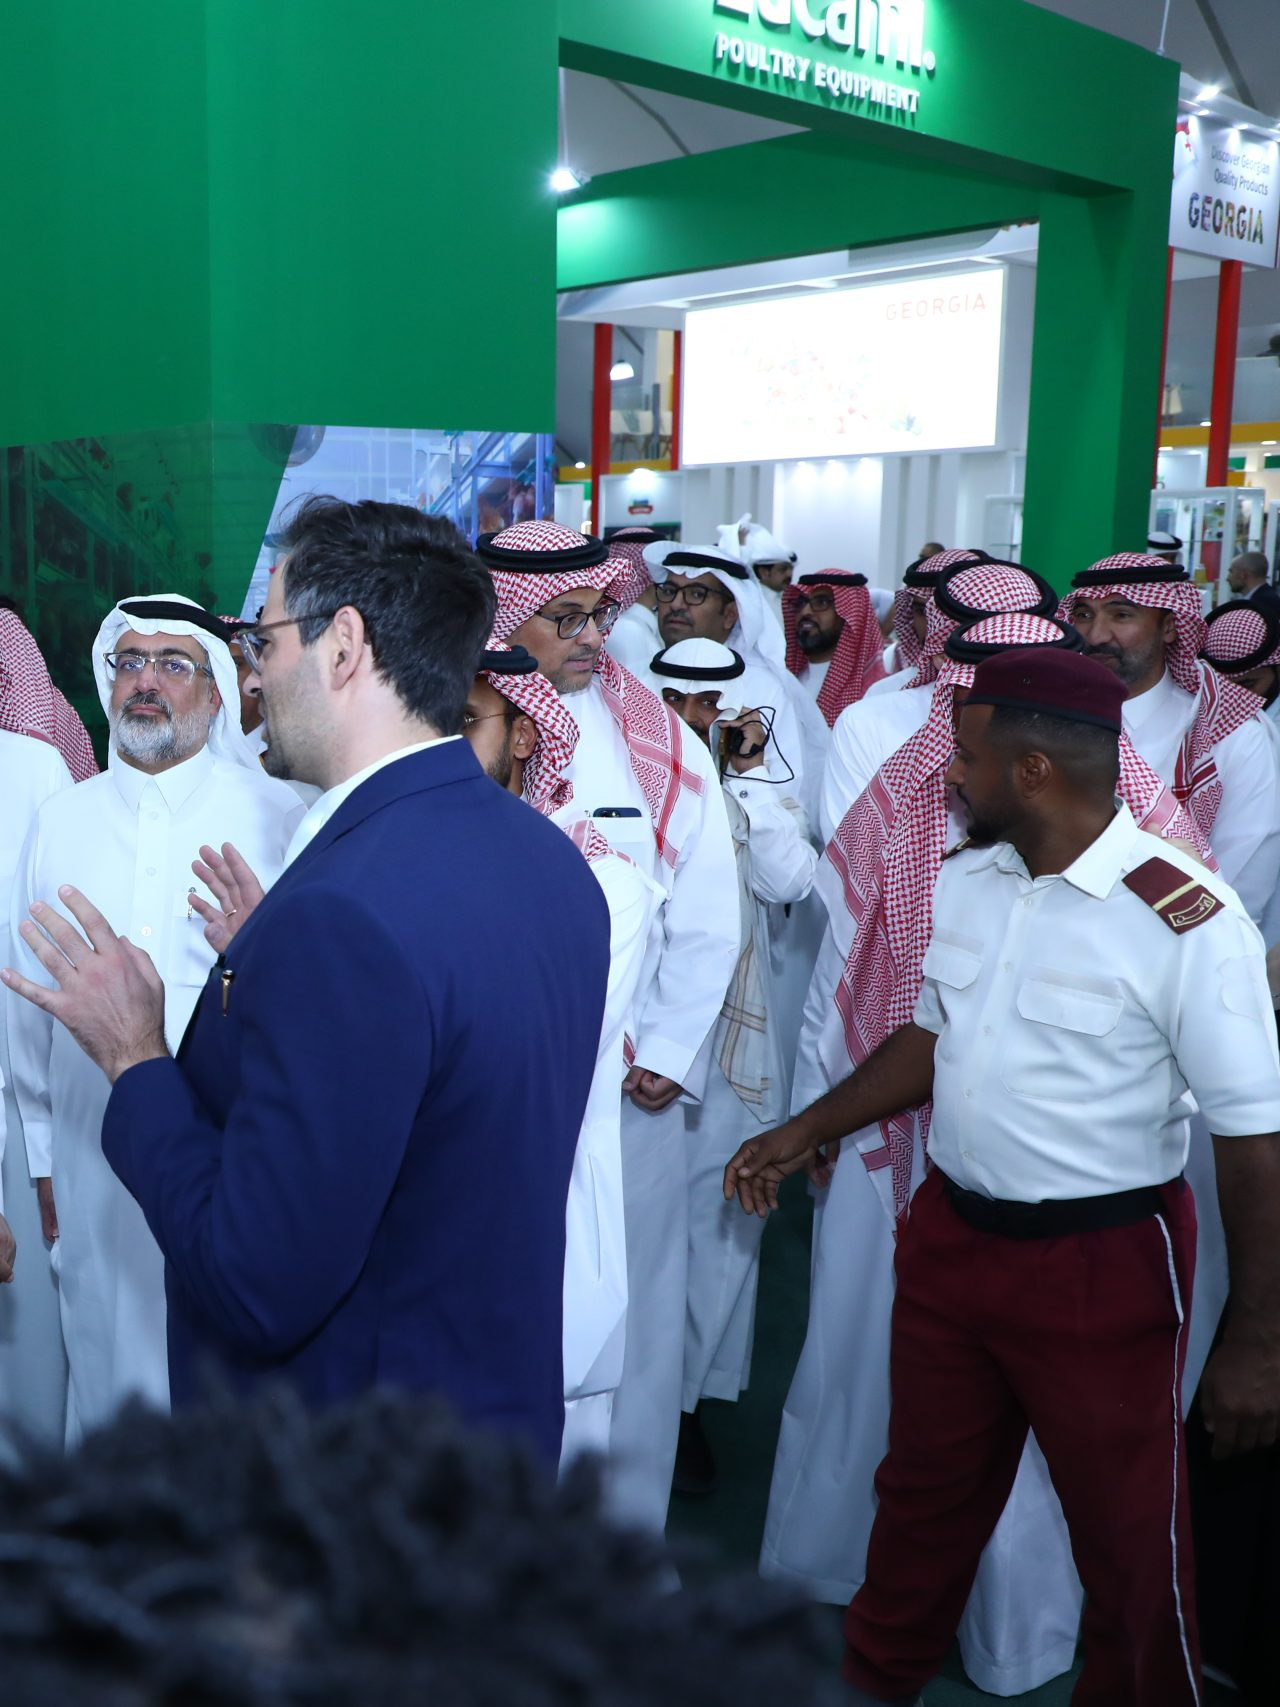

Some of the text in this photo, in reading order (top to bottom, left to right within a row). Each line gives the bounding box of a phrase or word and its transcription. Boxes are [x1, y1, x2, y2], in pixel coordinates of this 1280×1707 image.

[716, 33, 920, 113] POULTRY EQUIPMENT
[1214, 168, 1268, 196] Quality Products
[1188, 192, 1264, 244] GEORGIA
[886, 293, 986, 320] GEORGIA
